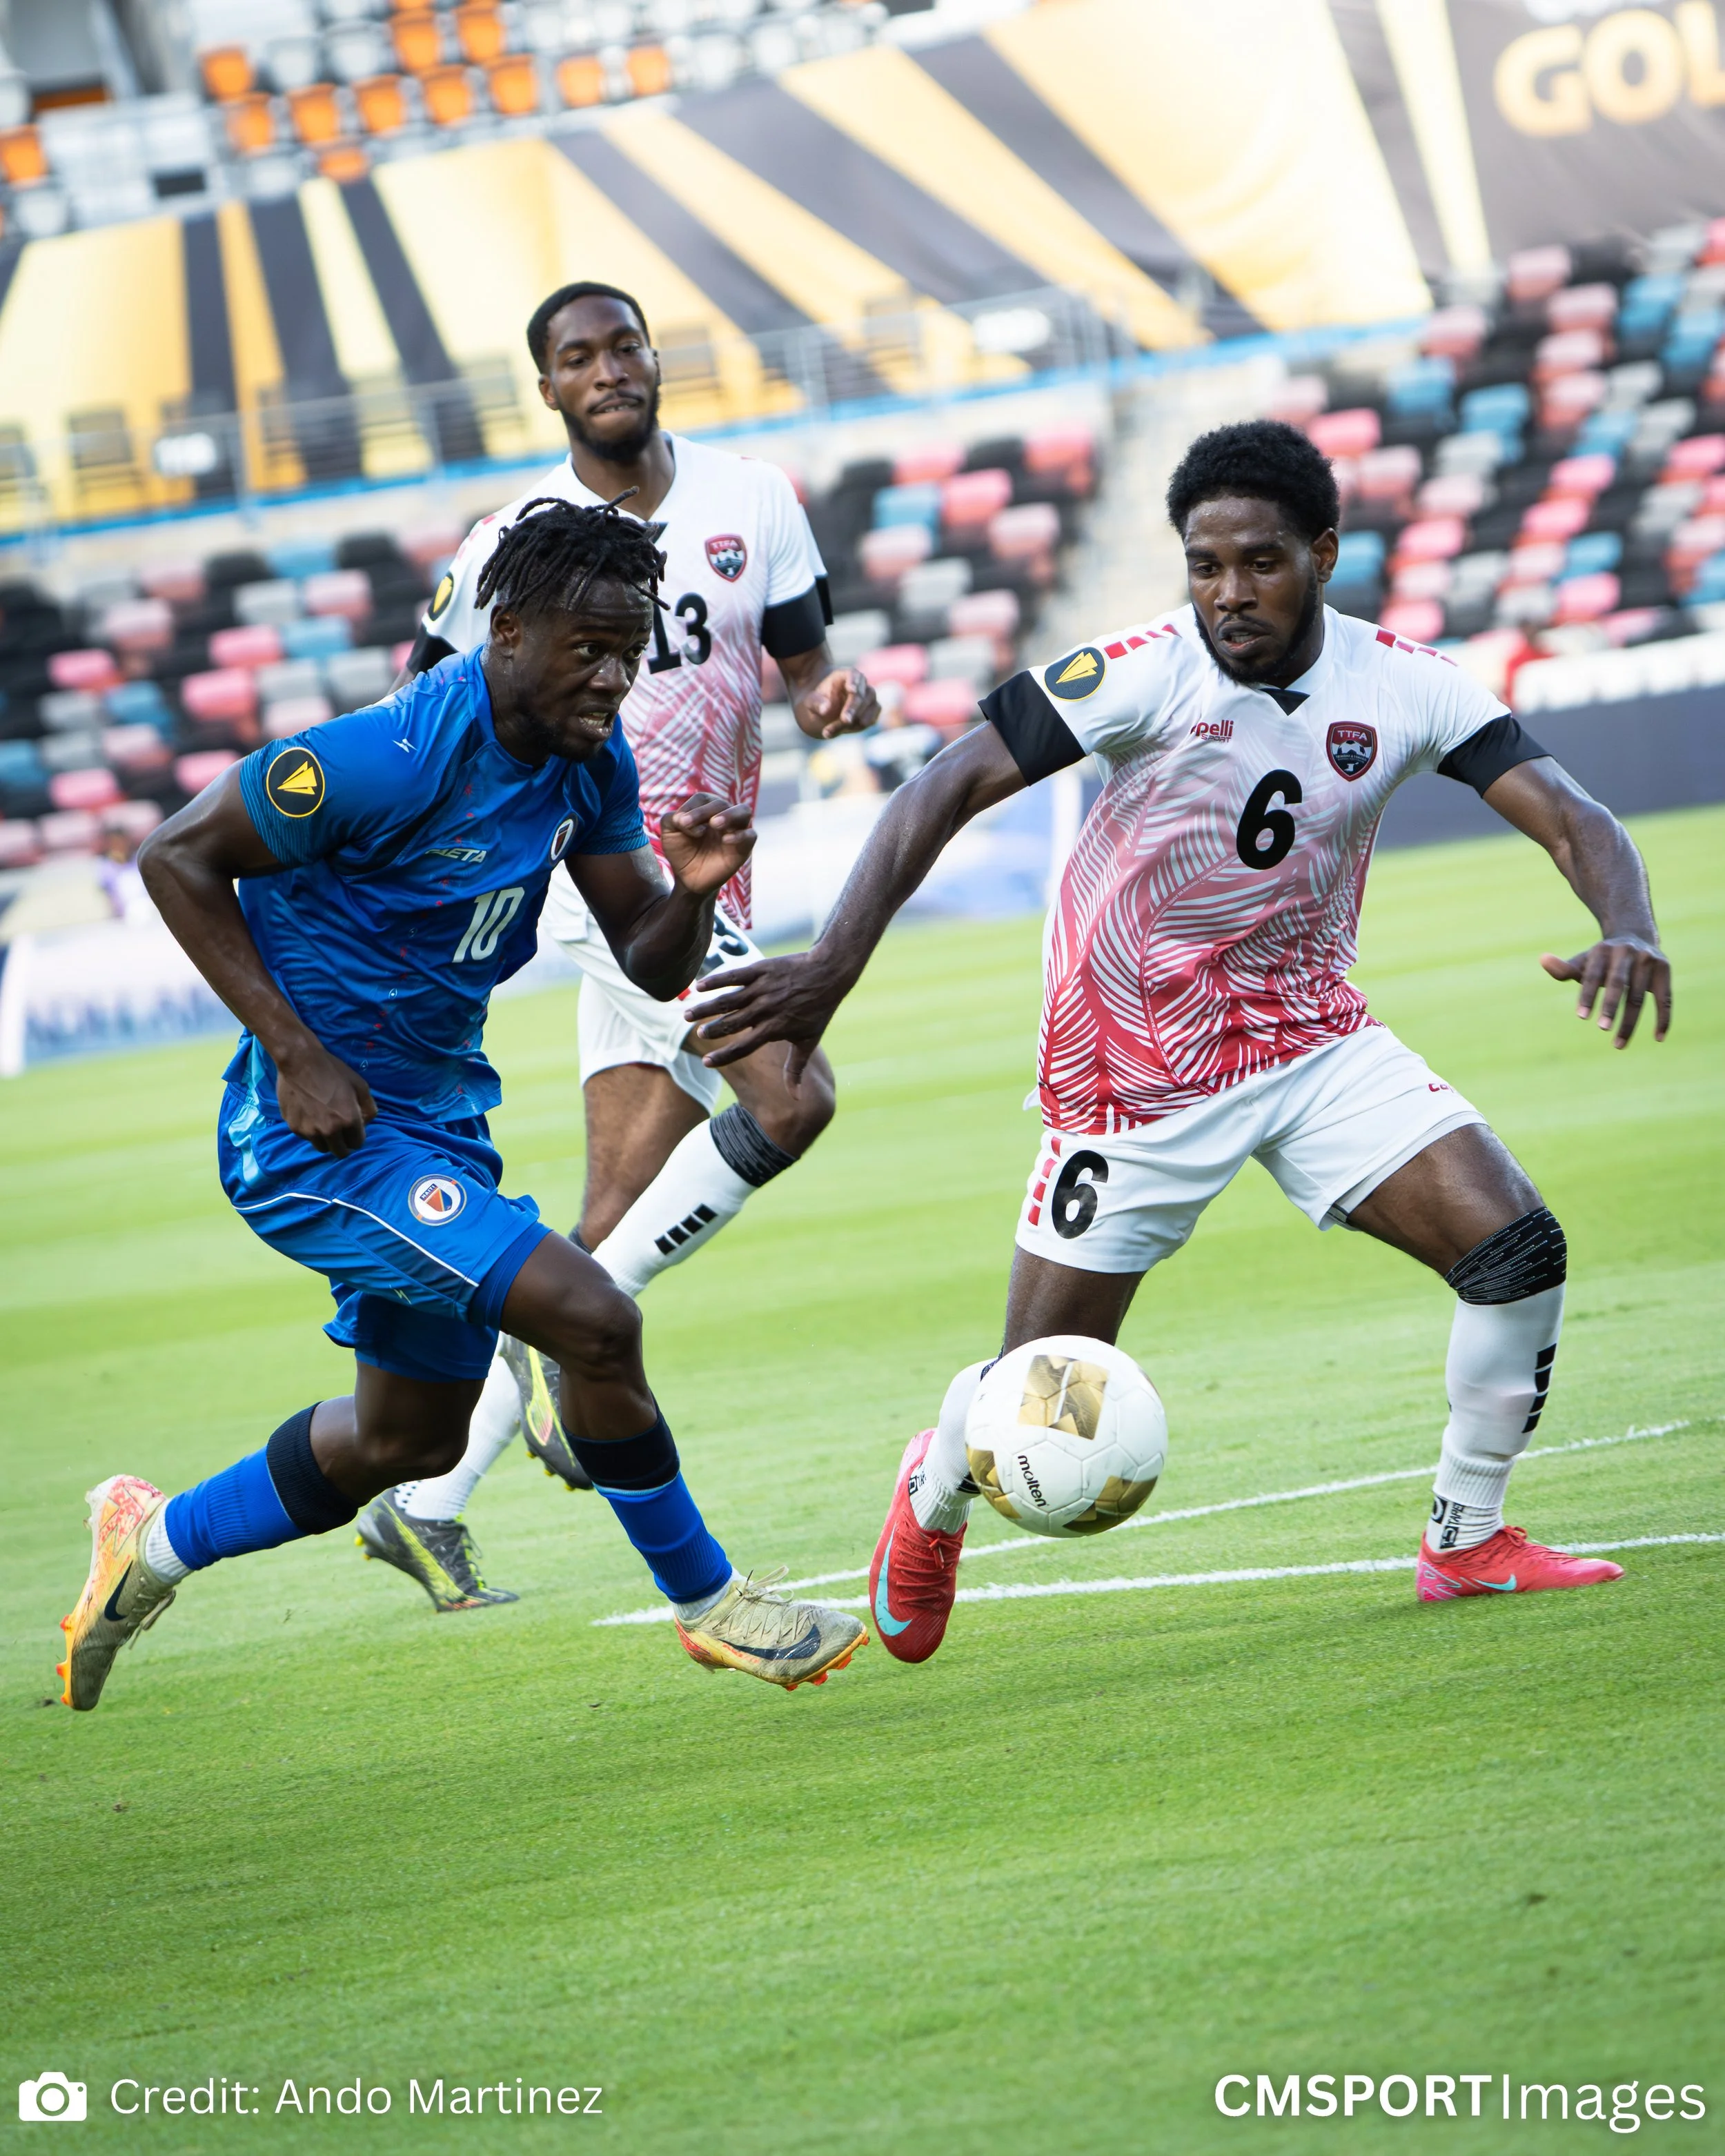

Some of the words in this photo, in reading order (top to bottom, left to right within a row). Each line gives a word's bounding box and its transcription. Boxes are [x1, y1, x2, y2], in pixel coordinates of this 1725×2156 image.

[647, 592, 711, 675] 13
[1337, 730, 1368, 741] TTFA
[1236, 769, 1303, 869] 6
[453, 886, 525, 964] 10
[420, 1184, 437, 1200] HAITI
[1052, 1149, 1109, 1239] 6
[1018, 1455, 1047, 1507] molten
